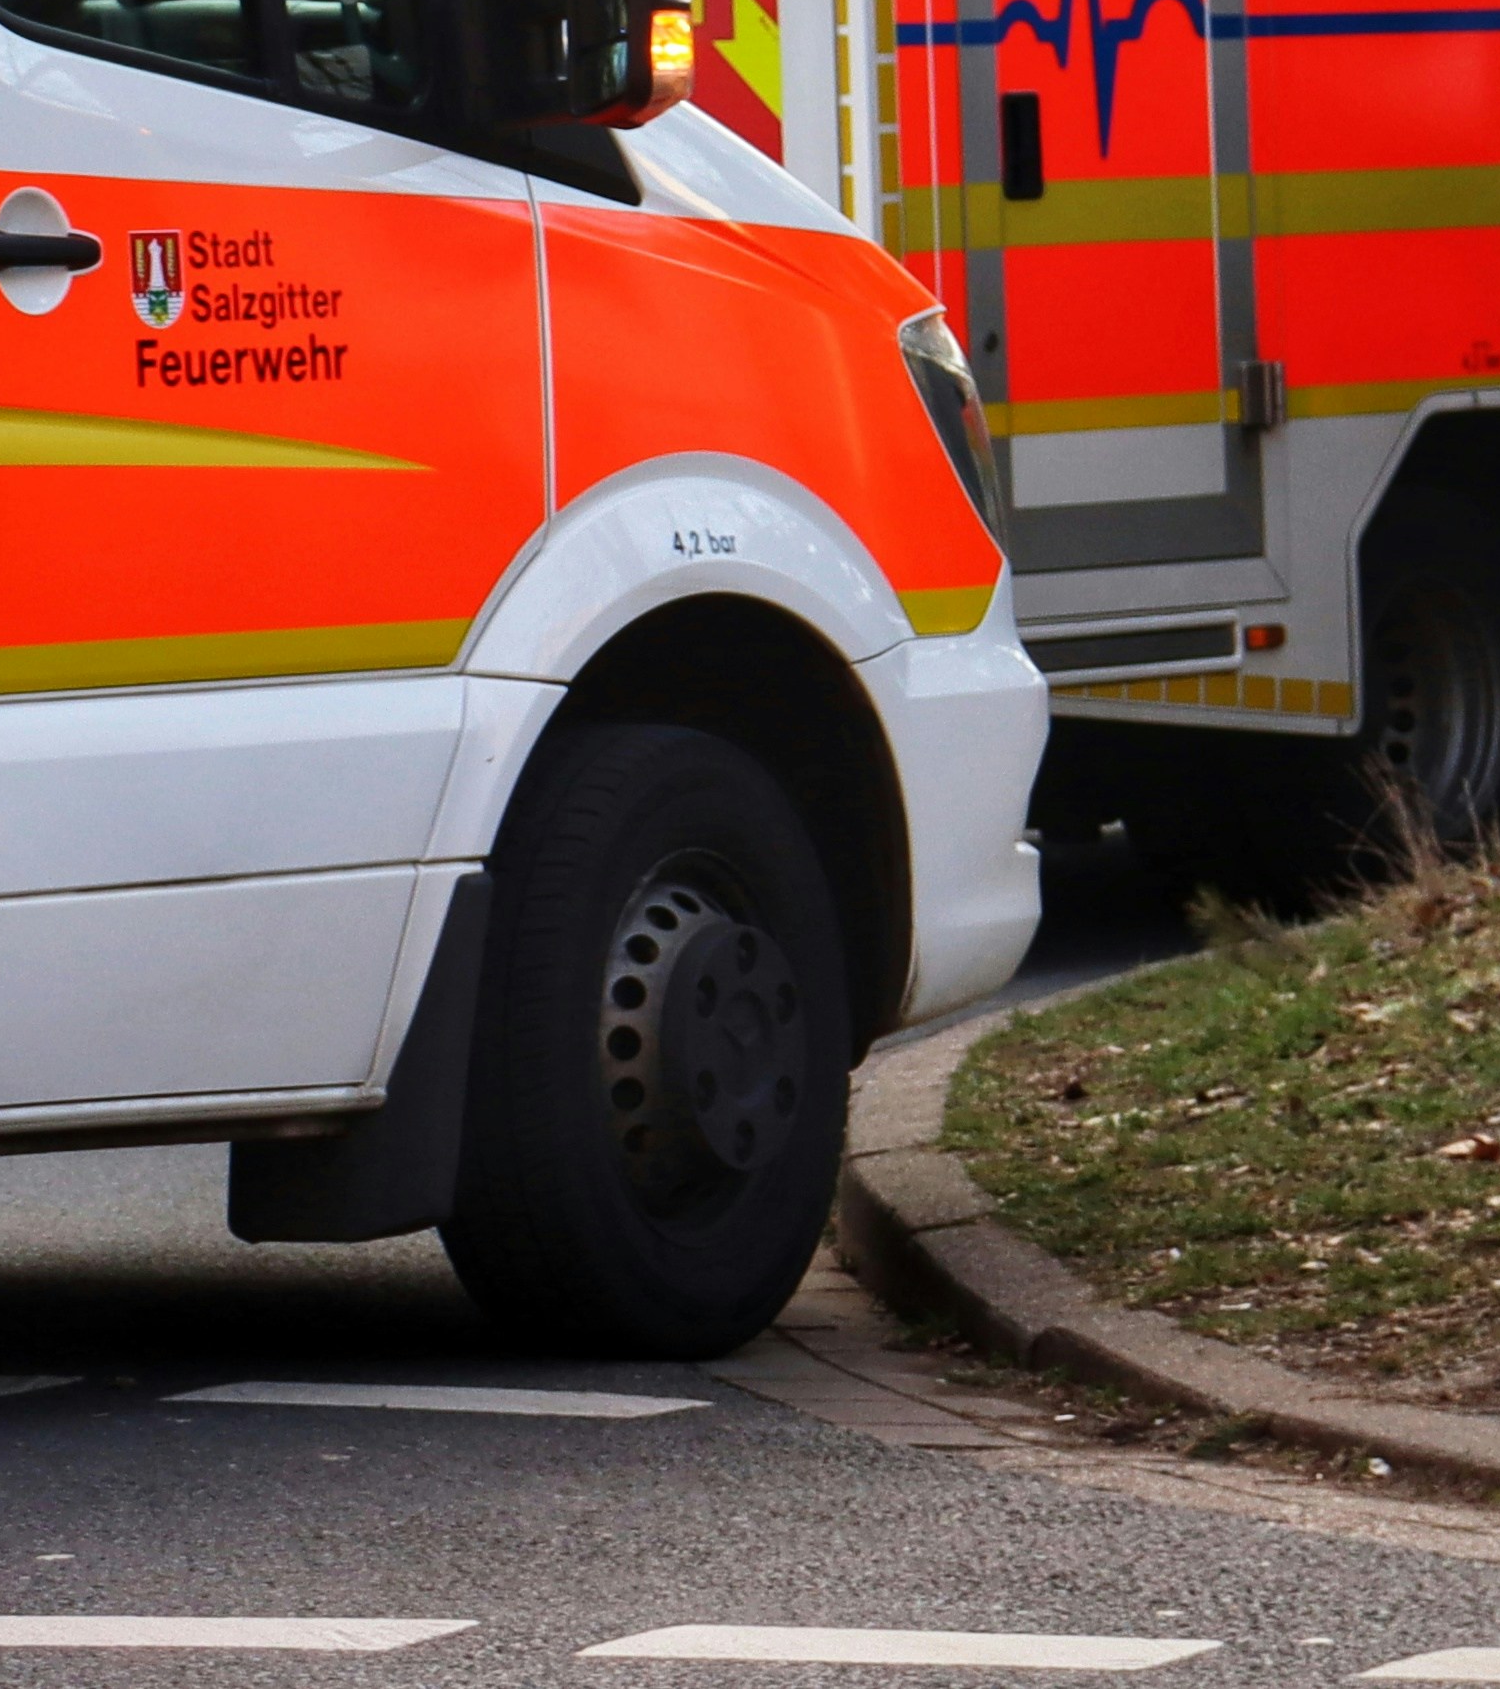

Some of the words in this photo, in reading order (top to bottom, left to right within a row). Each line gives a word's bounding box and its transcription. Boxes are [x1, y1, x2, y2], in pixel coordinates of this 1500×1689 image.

[187, 229, 275, 270] Stadt
[190, 282, 343, 331] Salzgitter
[135, 334, 348, 388] Feuerwehr
[672, 530, 703, 558] 4,2
[705, 528, 737, 555] bar
